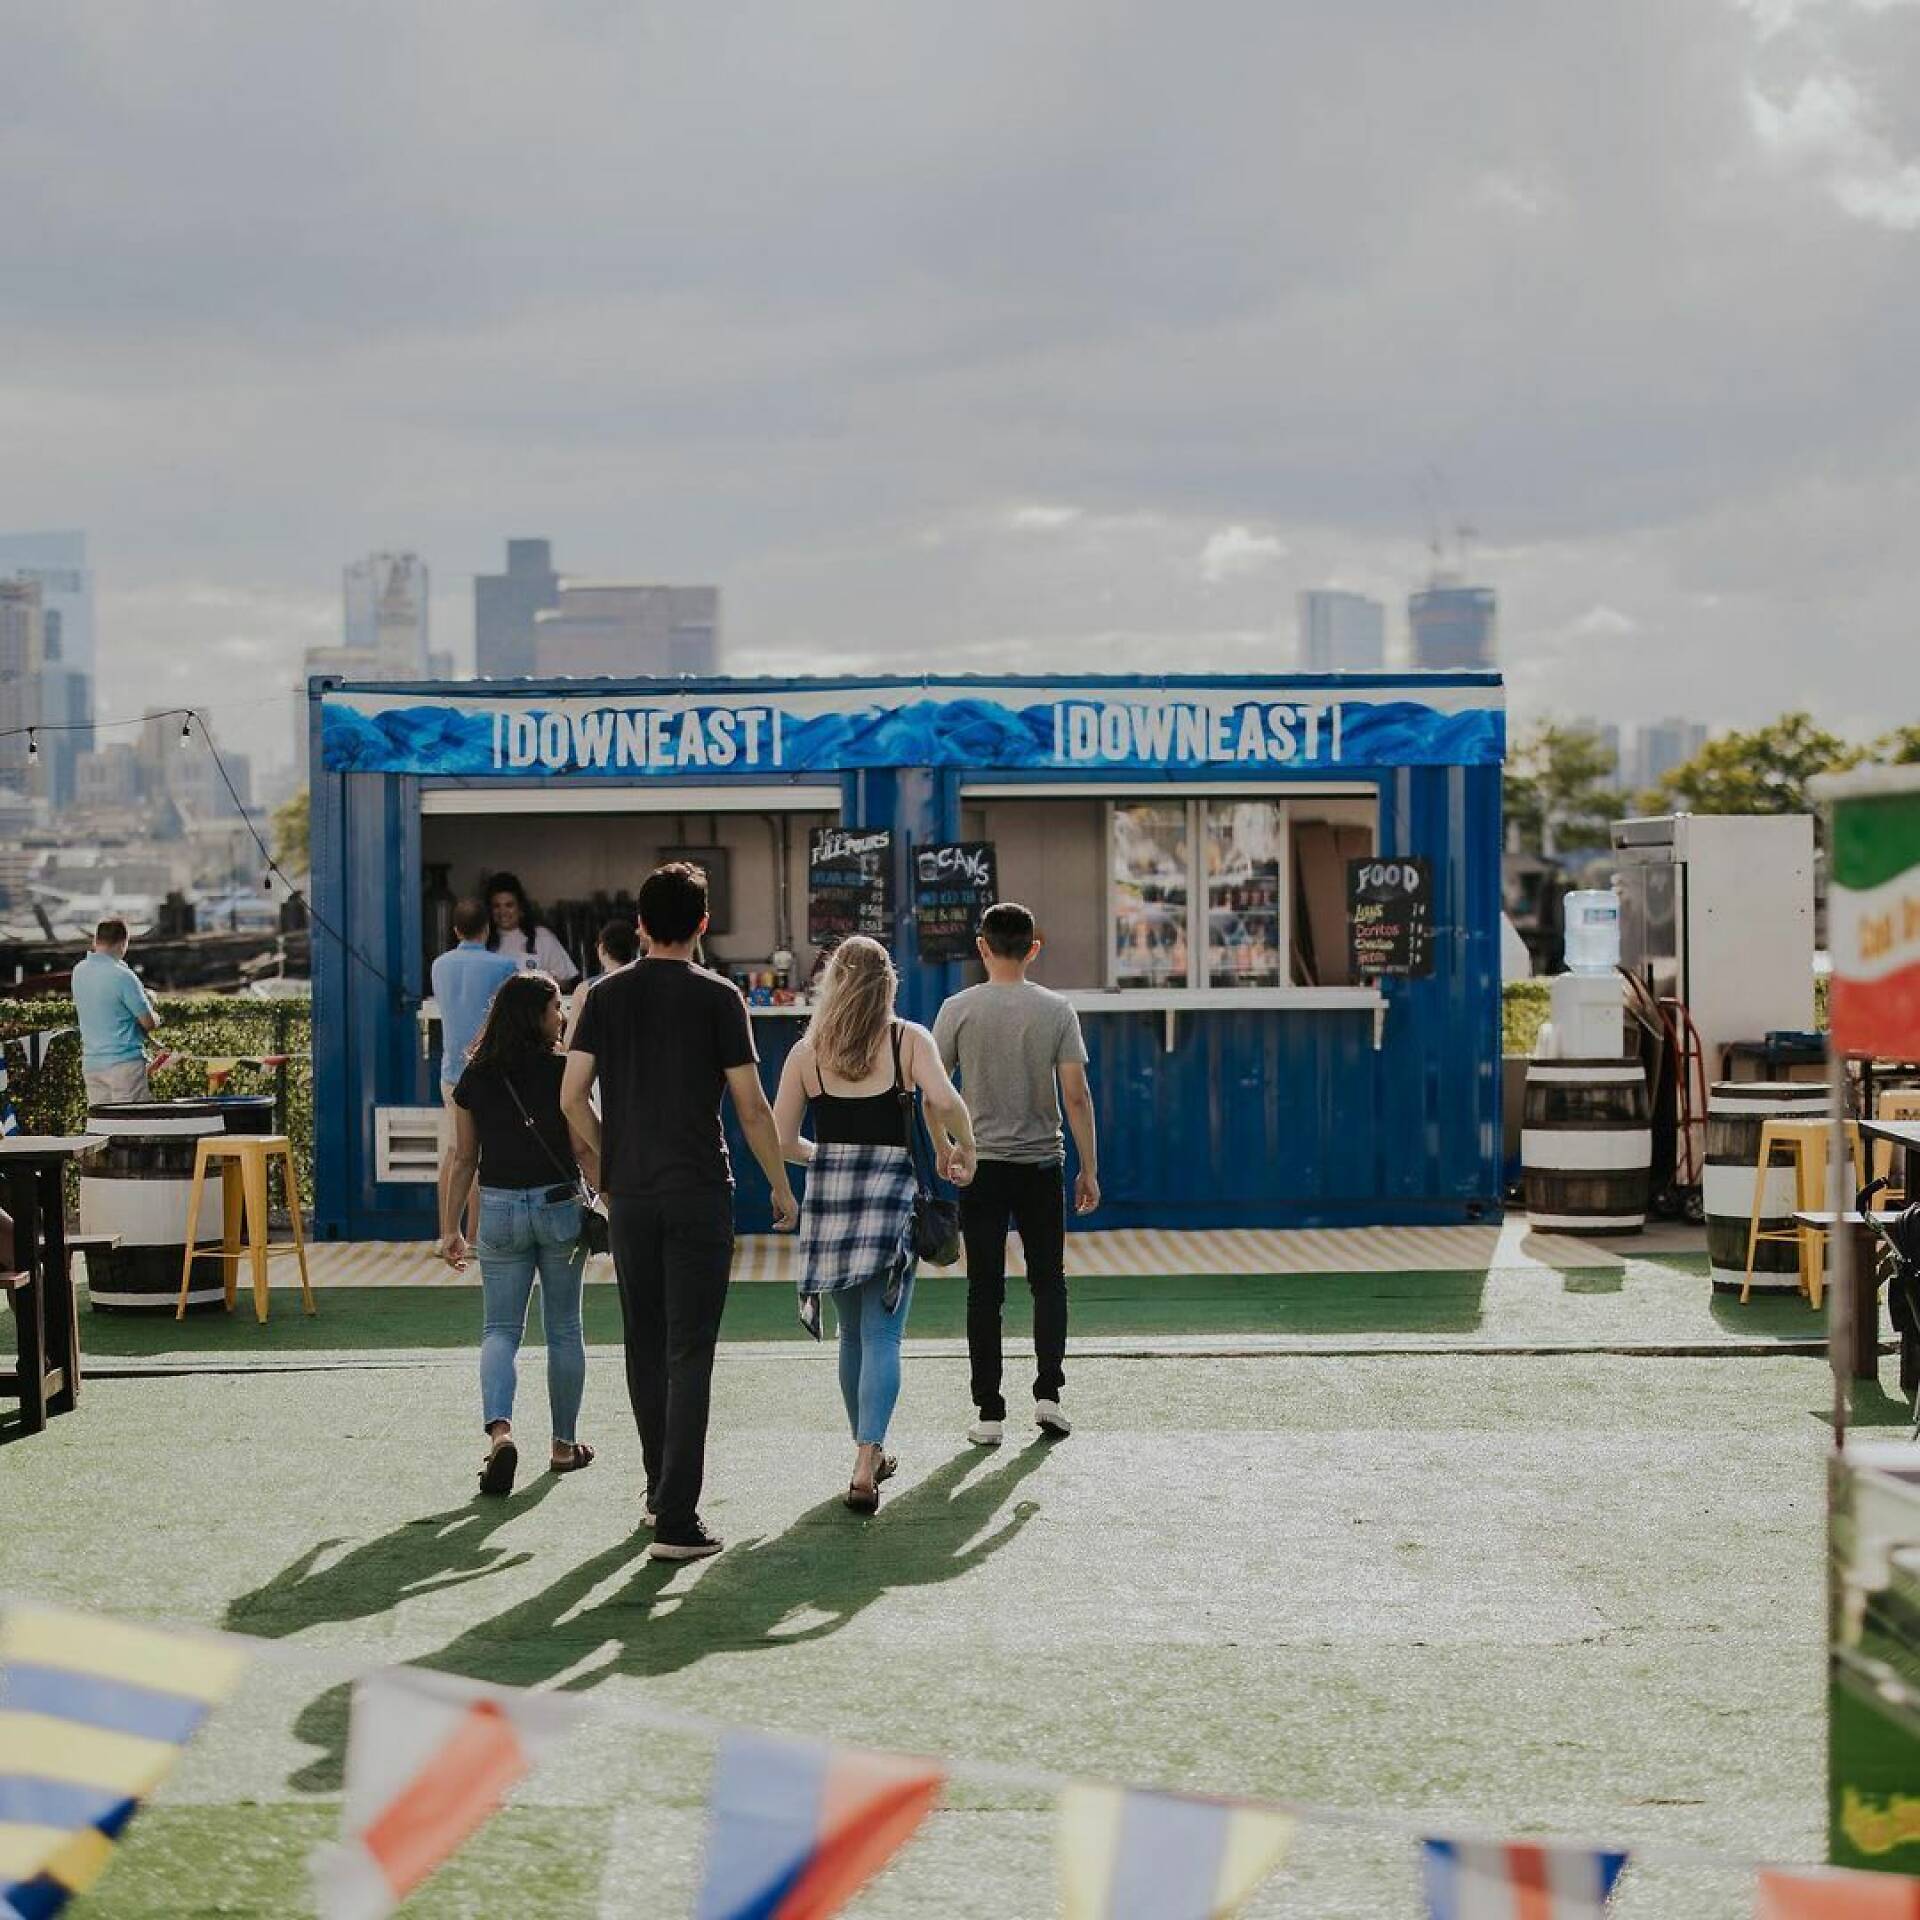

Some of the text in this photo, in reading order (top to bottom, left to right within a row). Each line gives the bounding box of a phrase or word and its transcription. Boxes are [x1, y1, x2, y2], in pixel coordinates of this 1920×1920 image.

[508, 709, 766, 768] DOWNEAST
[1069, 705, 1327, 762] DOWNEAST
[938, 847, 989, 886] CANS
[1356, 864, 1420, 893] FOOD
